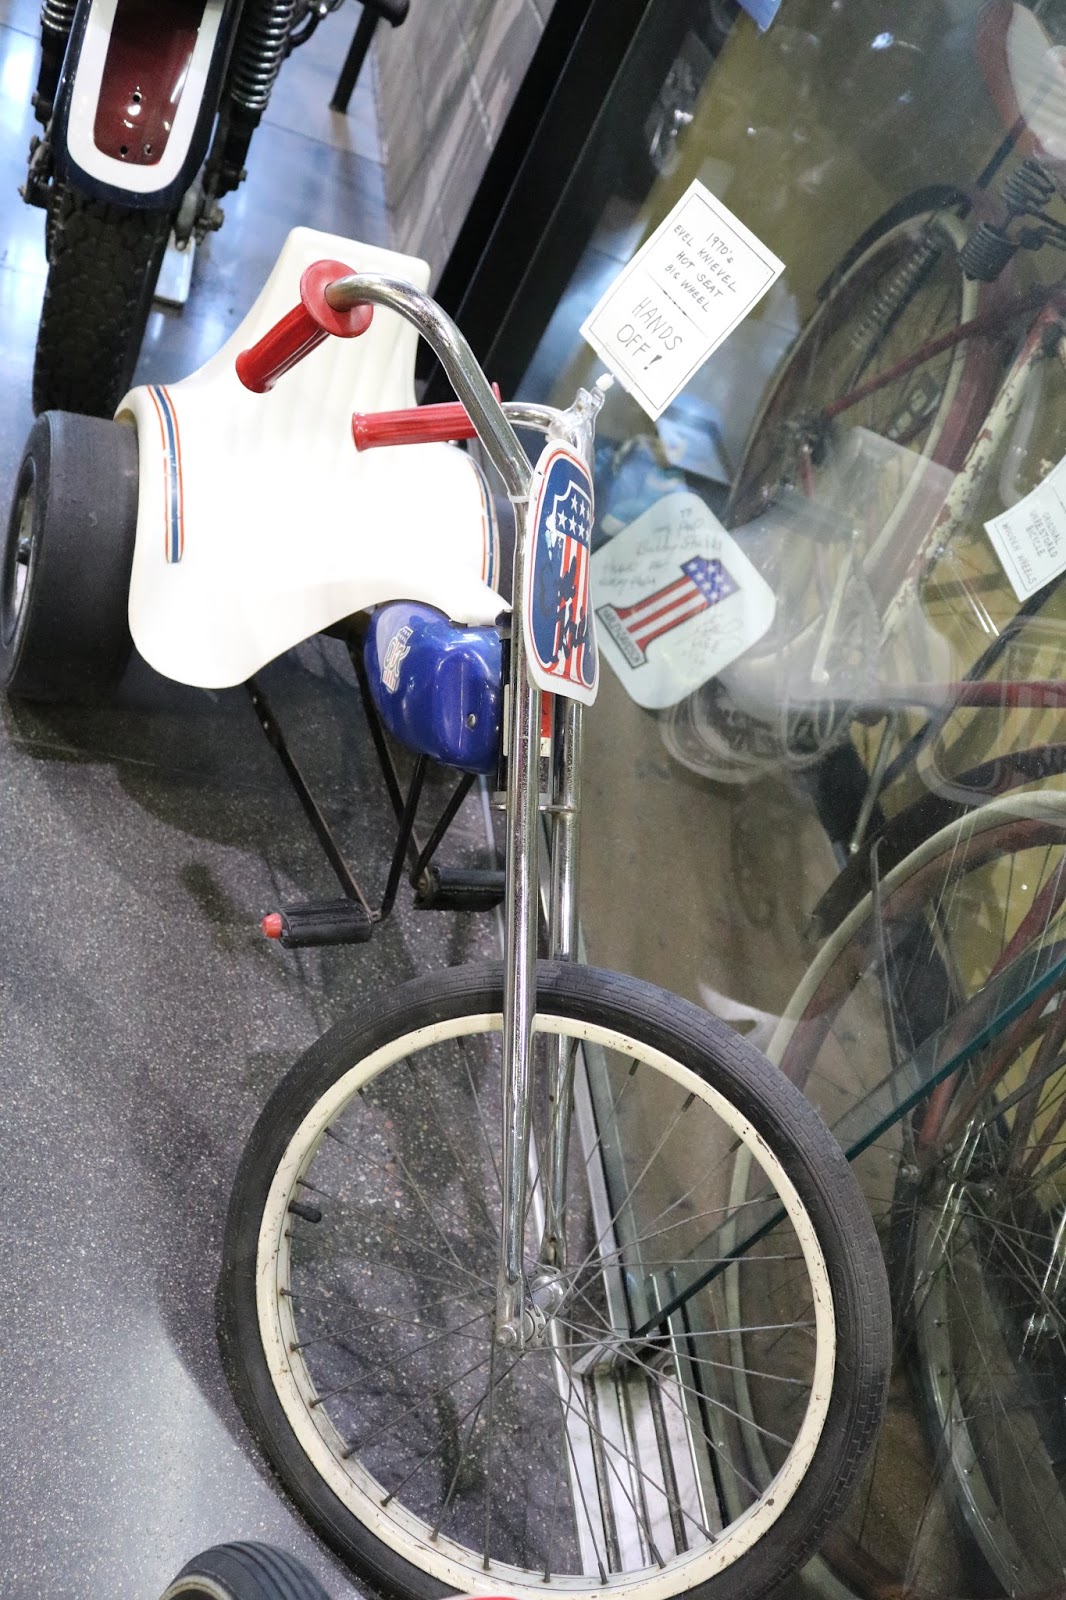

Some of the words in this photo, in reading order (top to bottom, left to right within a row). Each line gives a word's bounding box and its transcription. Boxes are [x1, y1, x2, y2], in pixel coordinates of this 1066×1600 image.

[673, 224, 693, 247] EVEL
[697, 248, 736, 293] KNIEVEL
[706, 232, 734, 264] 1970's
[664, 263, 680, 280] BIG
[680, 280, 709, 313] WHEEL
[676, 250, 695, 269] HOT
[696, 272, 724, 299] SEAT
[632, 297, 683, 350] HANDS
[1016, 554, 1037, 585] WHEELS
